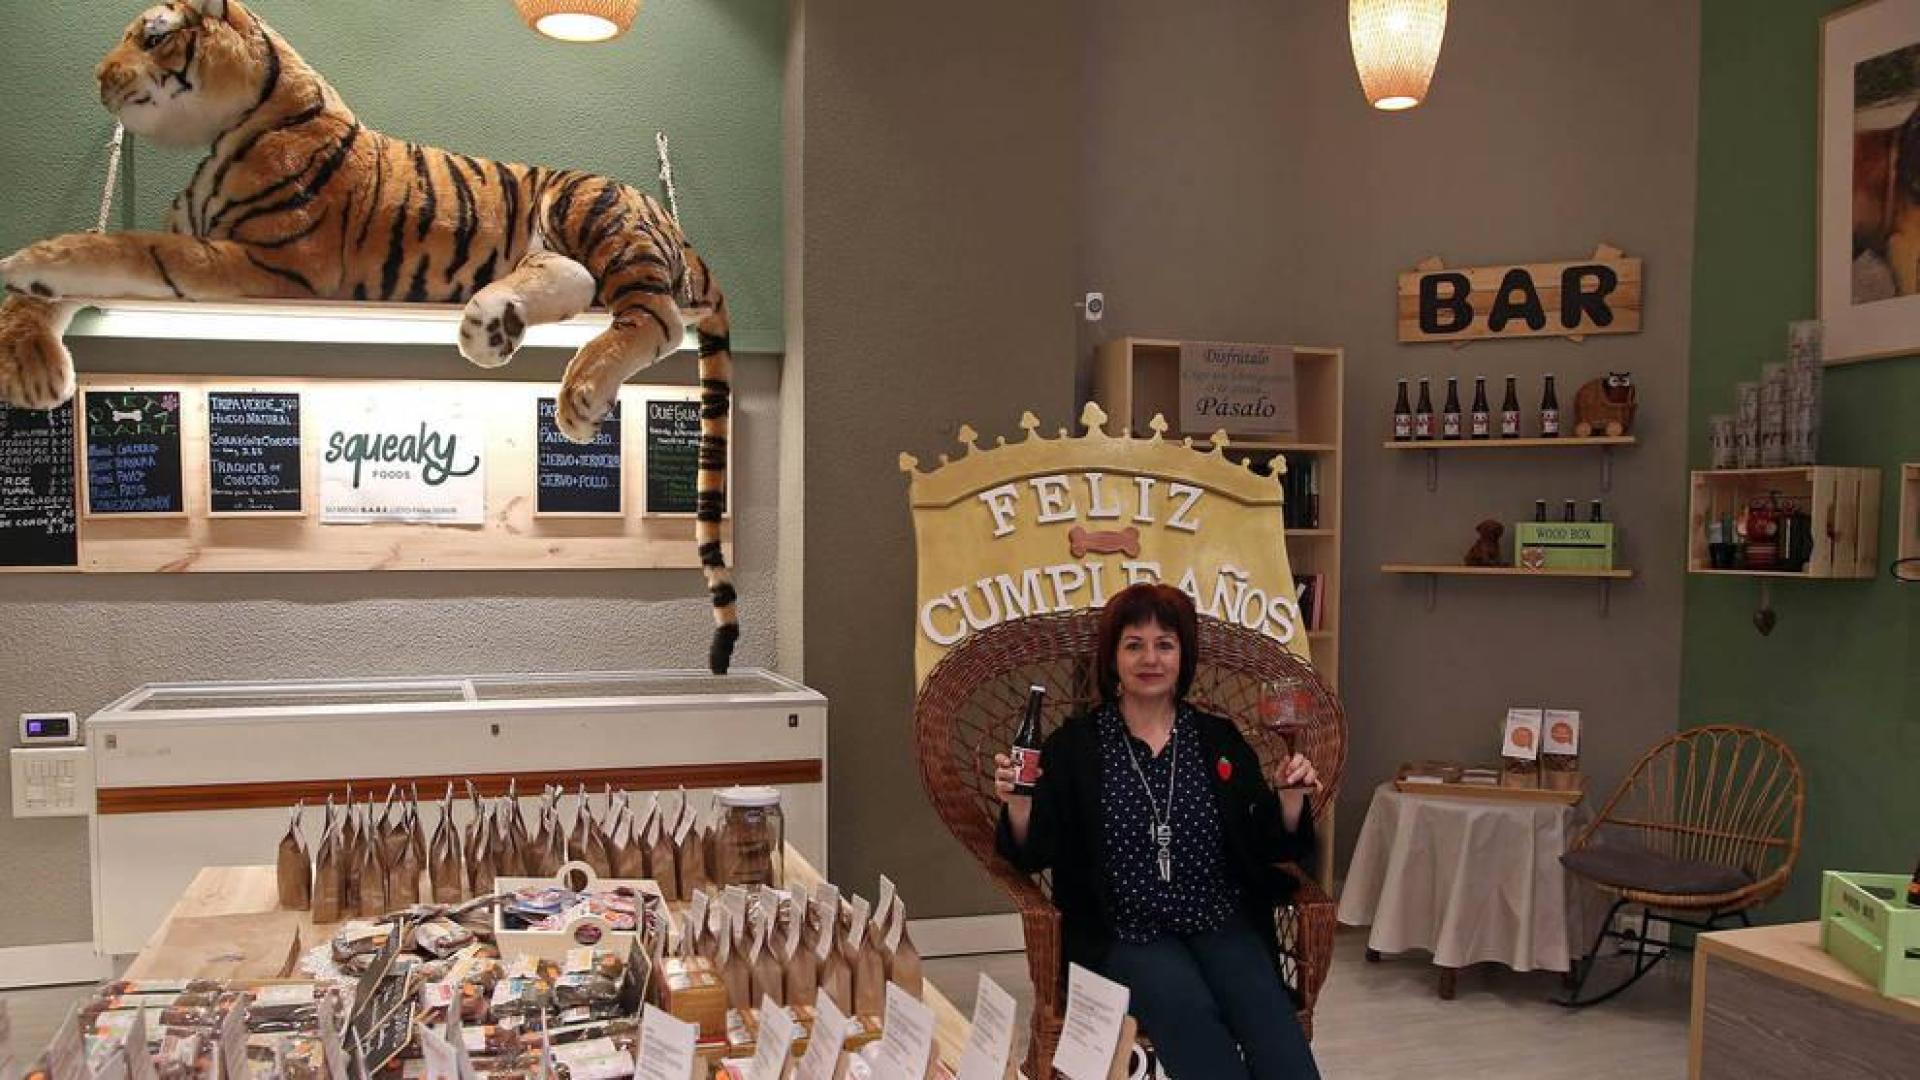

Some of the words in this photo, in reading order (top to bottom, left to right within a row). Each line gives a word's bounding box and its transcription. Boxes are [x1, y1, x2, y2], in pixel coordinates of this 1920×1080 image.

[1419, 264, 1618, 334] BAR
[326, 421, 480, 488] squeaky
[372, 471, 411, 479] FOODS
[978, 472, 1206, 538] FELIZ
[1536, 528, 1567, 540] WOOD
[1570, 528, 1592, 540] BOX
